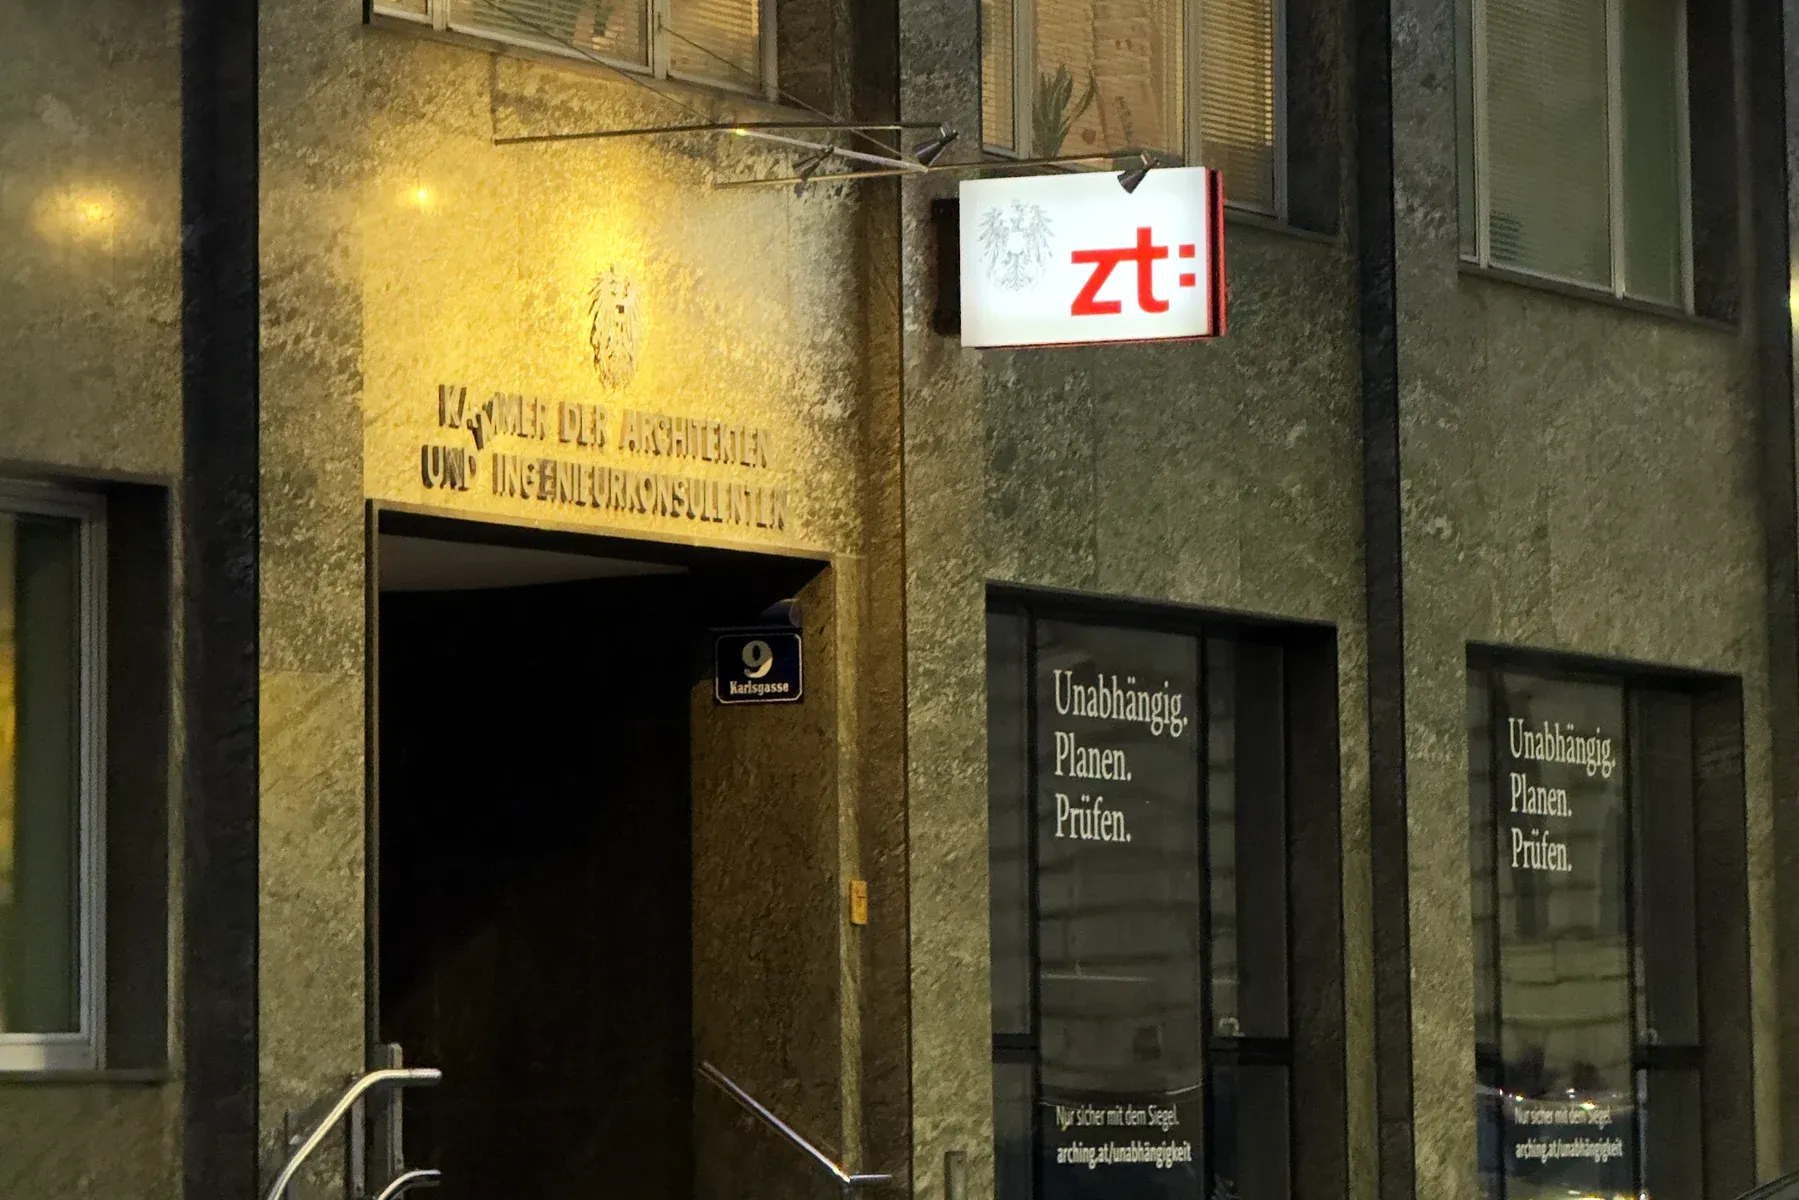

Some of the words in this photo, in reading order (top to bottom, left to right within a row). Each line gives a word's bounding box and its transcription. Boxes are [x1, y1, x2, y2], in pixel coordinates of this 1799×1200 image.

[558, 400, 607, 447] DER
[618, 408, 773, 469] ARCHITEKTEN
[421, 443, 478, 492] UND
[492, 452, 788, 531] INGENIEURKONSULENTEN
[742, 640, 773, 678] 9
[730, 680, 789, 696] Karlsgasse
[1053, 669, 1188, 737] Unabhängig.
[1054, 731, 1132, 782] Planen.
[1508, 717, 1616, 778] Unabhängig.
[1054, 793, 1132, 842] Prüfen.
[1509, 772, 1573, 817] Planen.
[1511, 827, 1573, 872] Prüfen.
[1056, 1105, 1074, 1126] Nur
[1076, 1103, 1105, 1126] sicher
[1107, 1104, 1124, 1126] mit
[1125, 1104, 1147, 1126] dem
[1148, 1103, 1180, 1132] Siegel.
[1056, 1140, 1192, 1170] arching.at/unabhängigkeit
